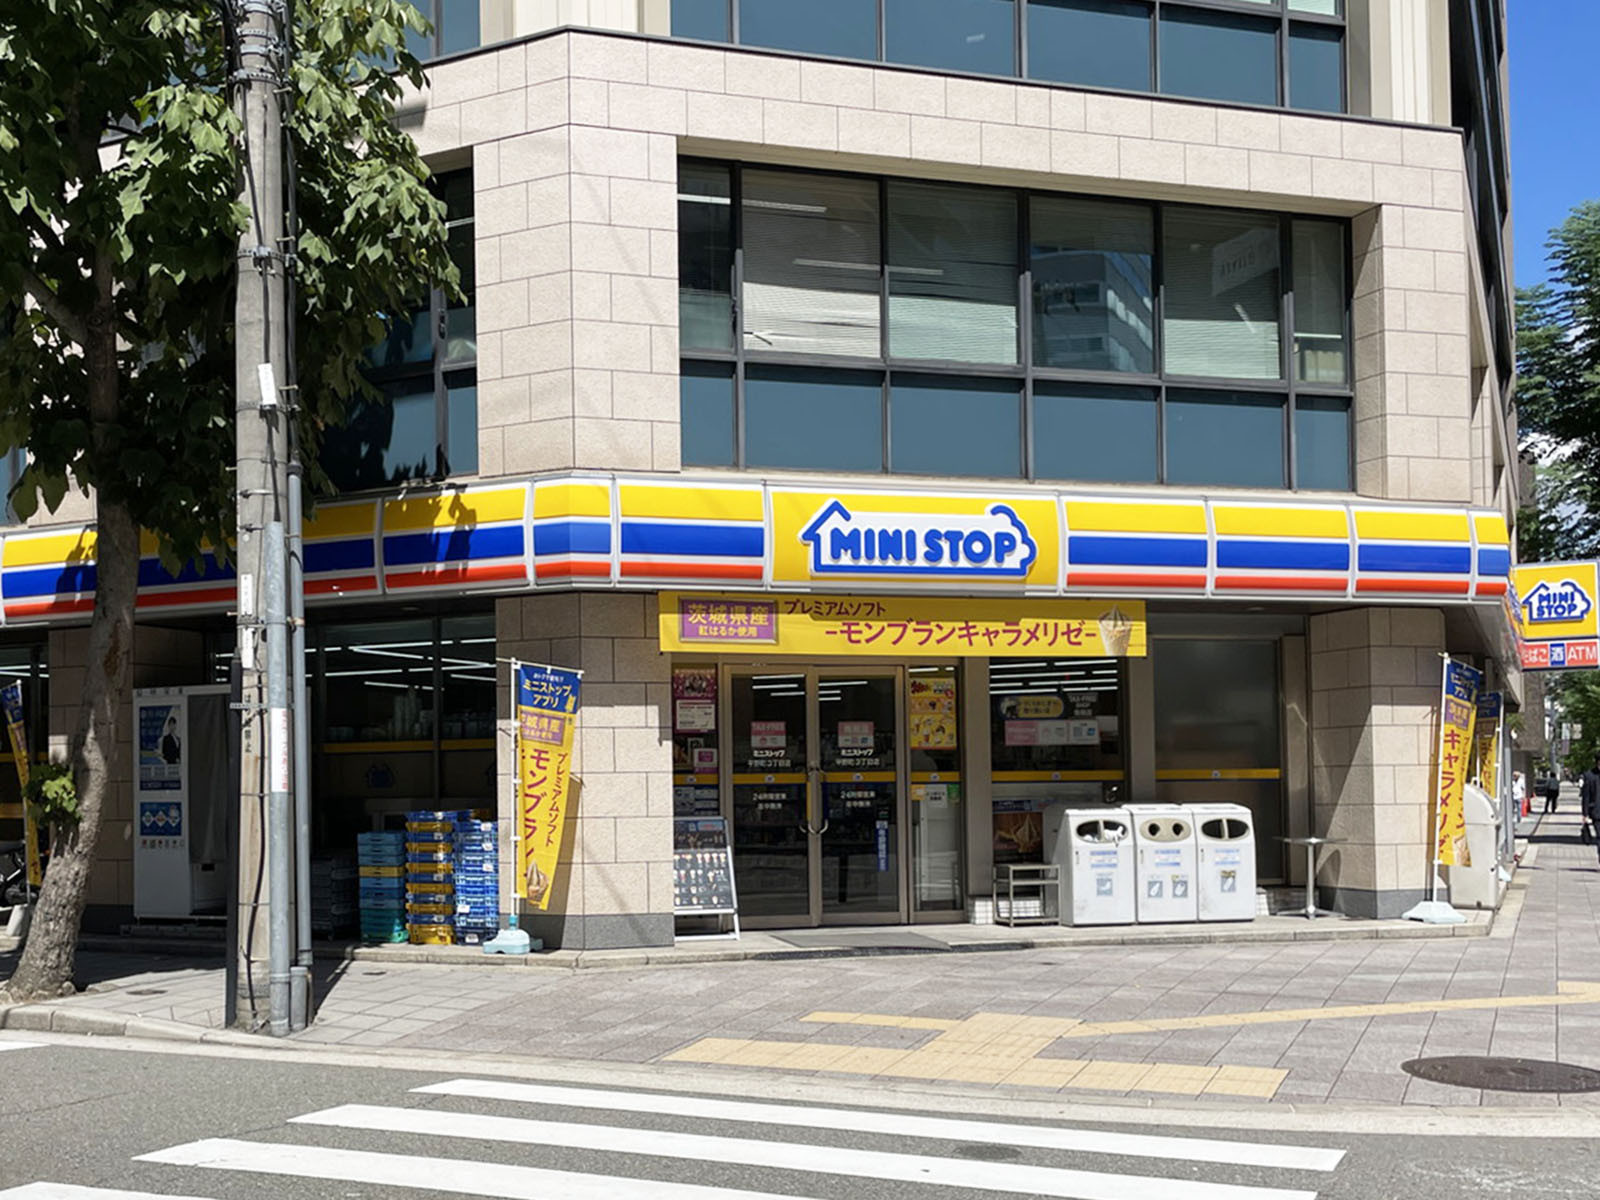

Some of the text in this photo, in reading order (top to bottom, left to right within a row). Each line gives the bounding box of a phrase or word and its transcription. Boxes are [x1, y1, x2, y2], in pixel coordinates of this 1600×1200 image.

[831, 528, 1017, 565] MINI STOP
[1538, 592, 1575, 604] MINI
[688, 604, 769, 626] 茨城県産
[784, 599, 886, 617] プレミアムソフト
[1537, 604, 1577, 617] STOP
[698, 626, 758, 637] 紅はるか使用
[1551, 647, 1564, 661] 酒
[1568, 645, 1597, 660] ATM
[522, 679, 572, 697] ミニストップ
[533, 694, 560, 708] アプリ
[545, 752, 568, 847] プレミアムソフト
